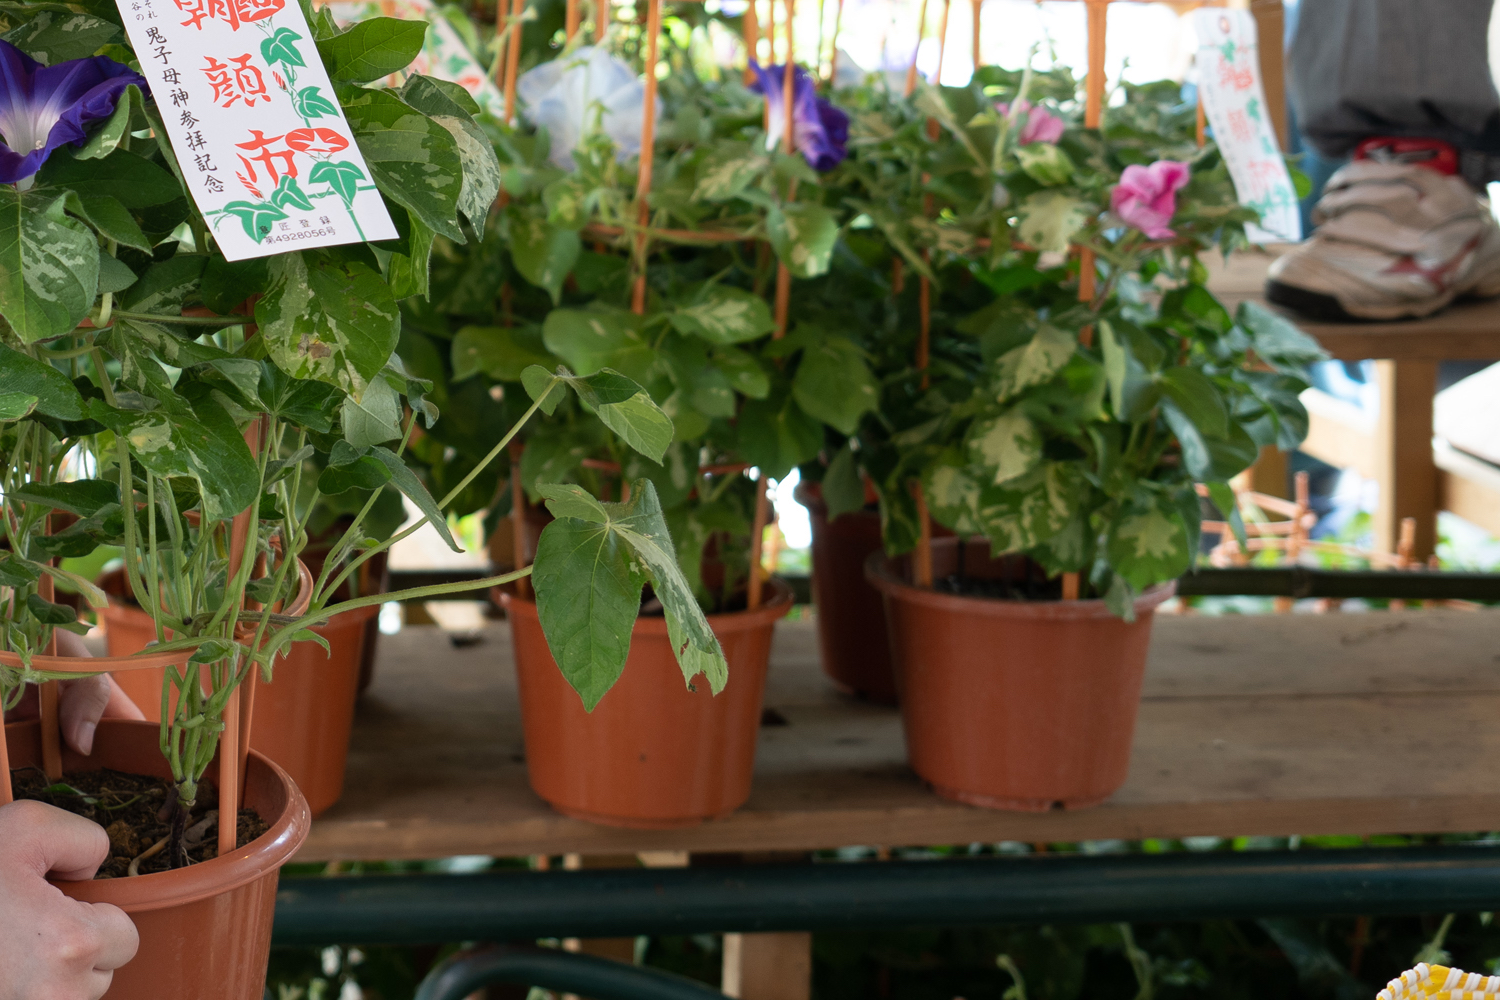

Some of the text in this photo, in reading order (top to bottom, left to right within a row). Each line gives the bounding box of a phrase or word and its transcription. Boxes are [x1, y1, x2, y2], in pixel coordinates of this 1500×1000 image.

[145, 25, 225, 195] 鬼子母神参拝記念
[264, 226, 337, 246] 第4928056号
